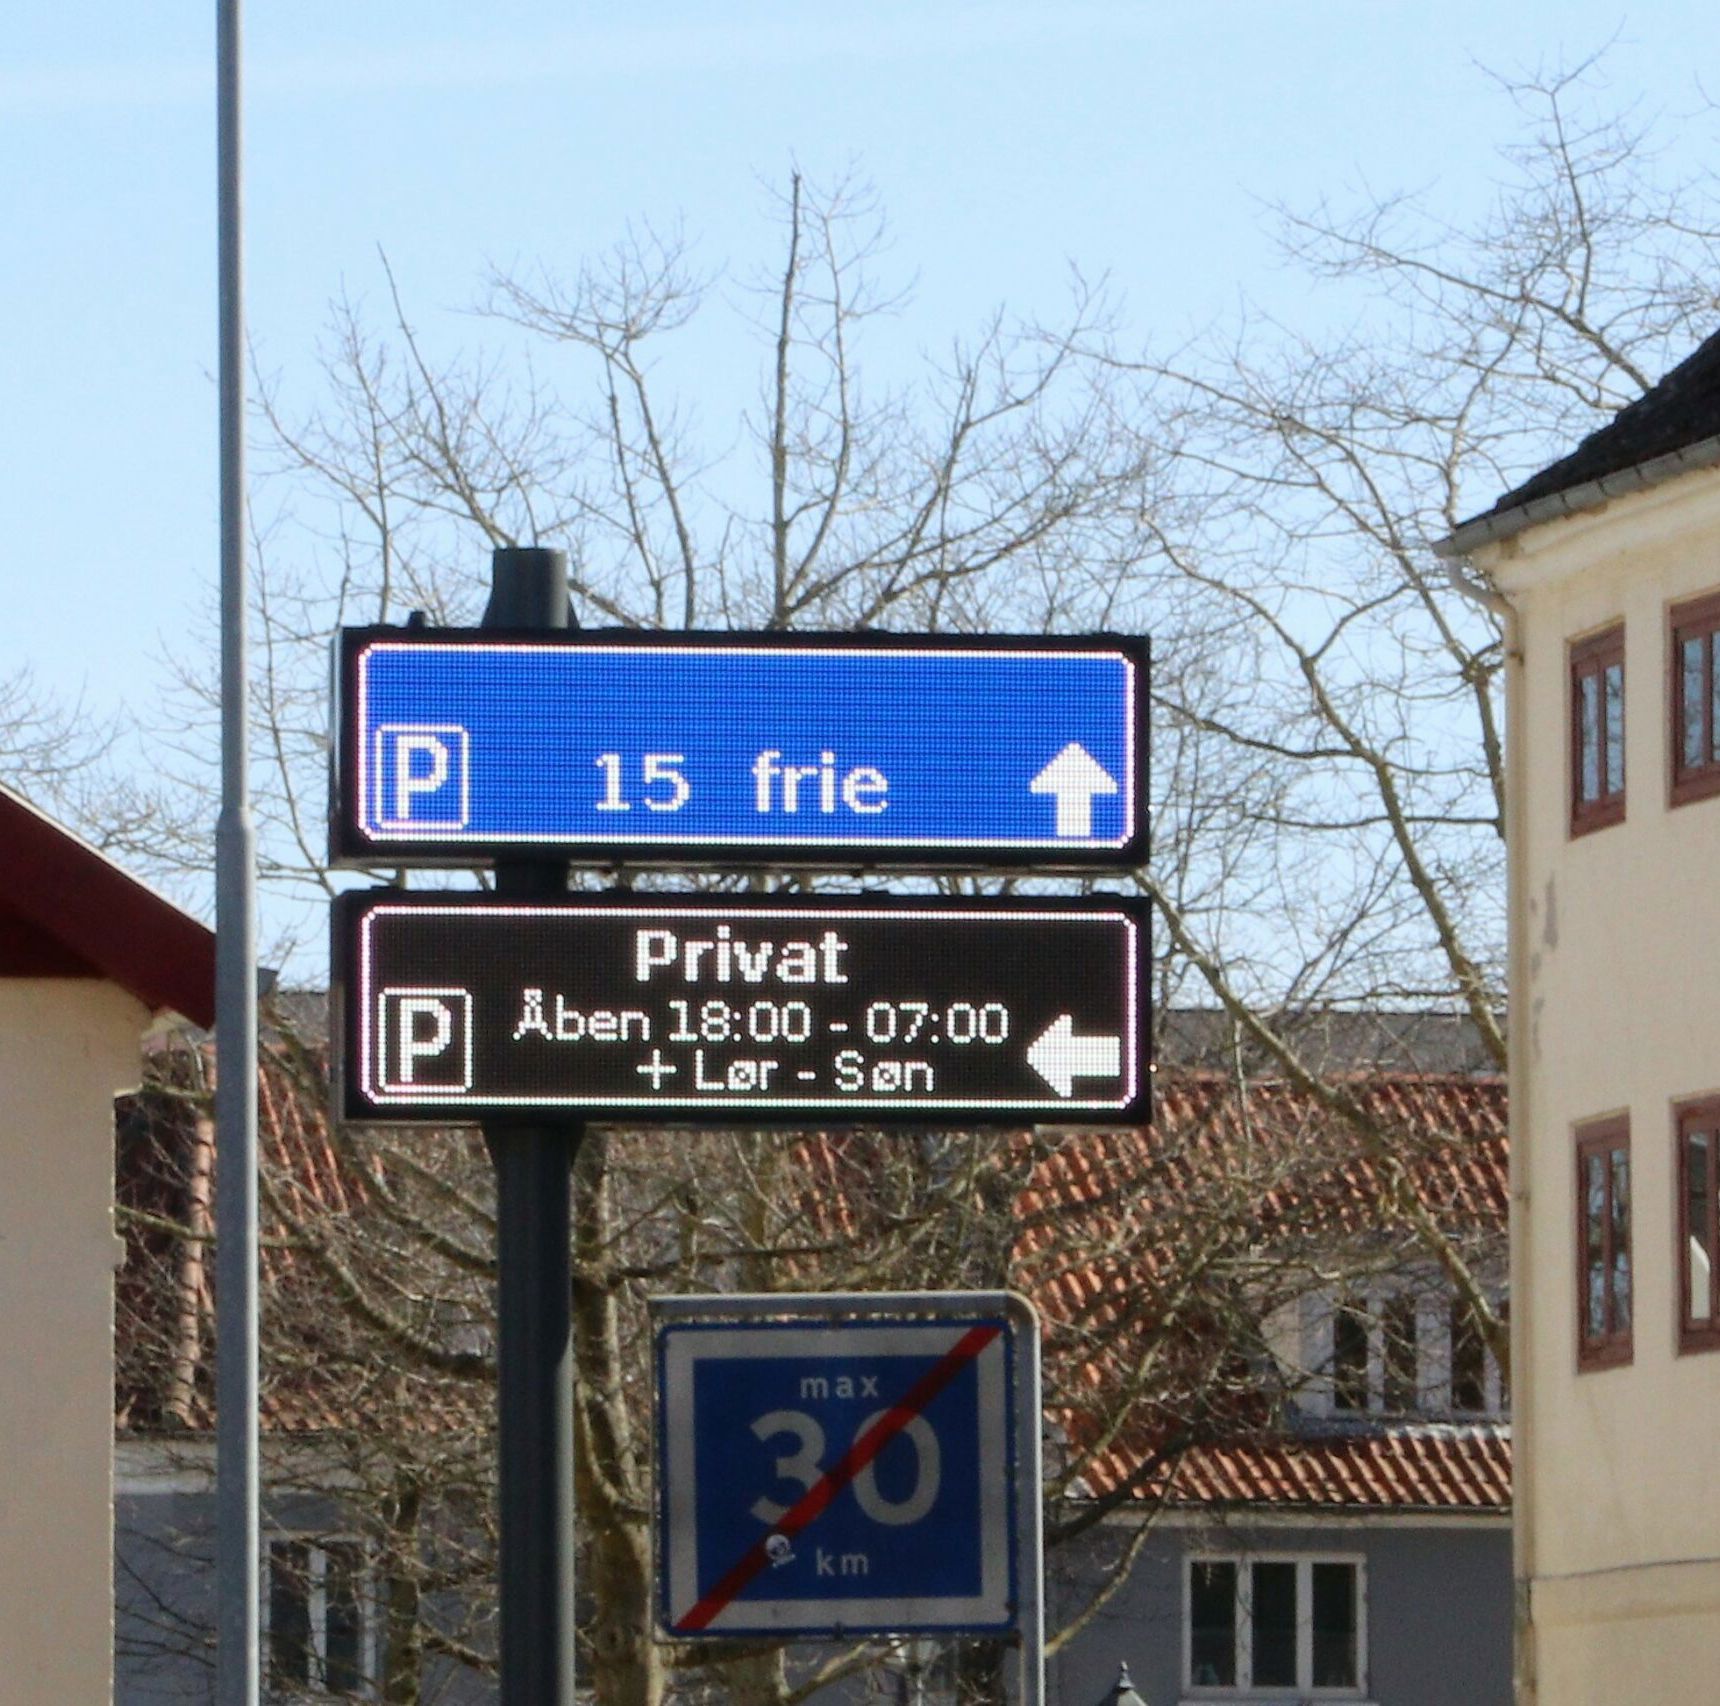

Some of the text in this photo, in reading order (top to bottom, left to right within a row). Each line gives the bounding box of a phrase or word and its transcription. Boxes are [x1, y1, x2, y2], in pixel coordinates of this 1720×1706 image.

[395, 734, 449, 820] P
[593, 750, 890, 815] 15 frie
[635, 925, 850, 985] Privat
[397, 998, 452, 1083] P
[512, 988, 651, 1042] Åben
[667, 1001, 812, 1043] 18:00
[865, 1002, 1009, 1045] 07:00
[636, 1051, 677, 1091] +
[694, 1049, 779, 1093] Lør
[833, 1050, 935, 1094] Søn
[800, 1374, 879, 1399] max
[749, 1407, 942, 1526] 30
[815, 1547, 870, 1576] km
